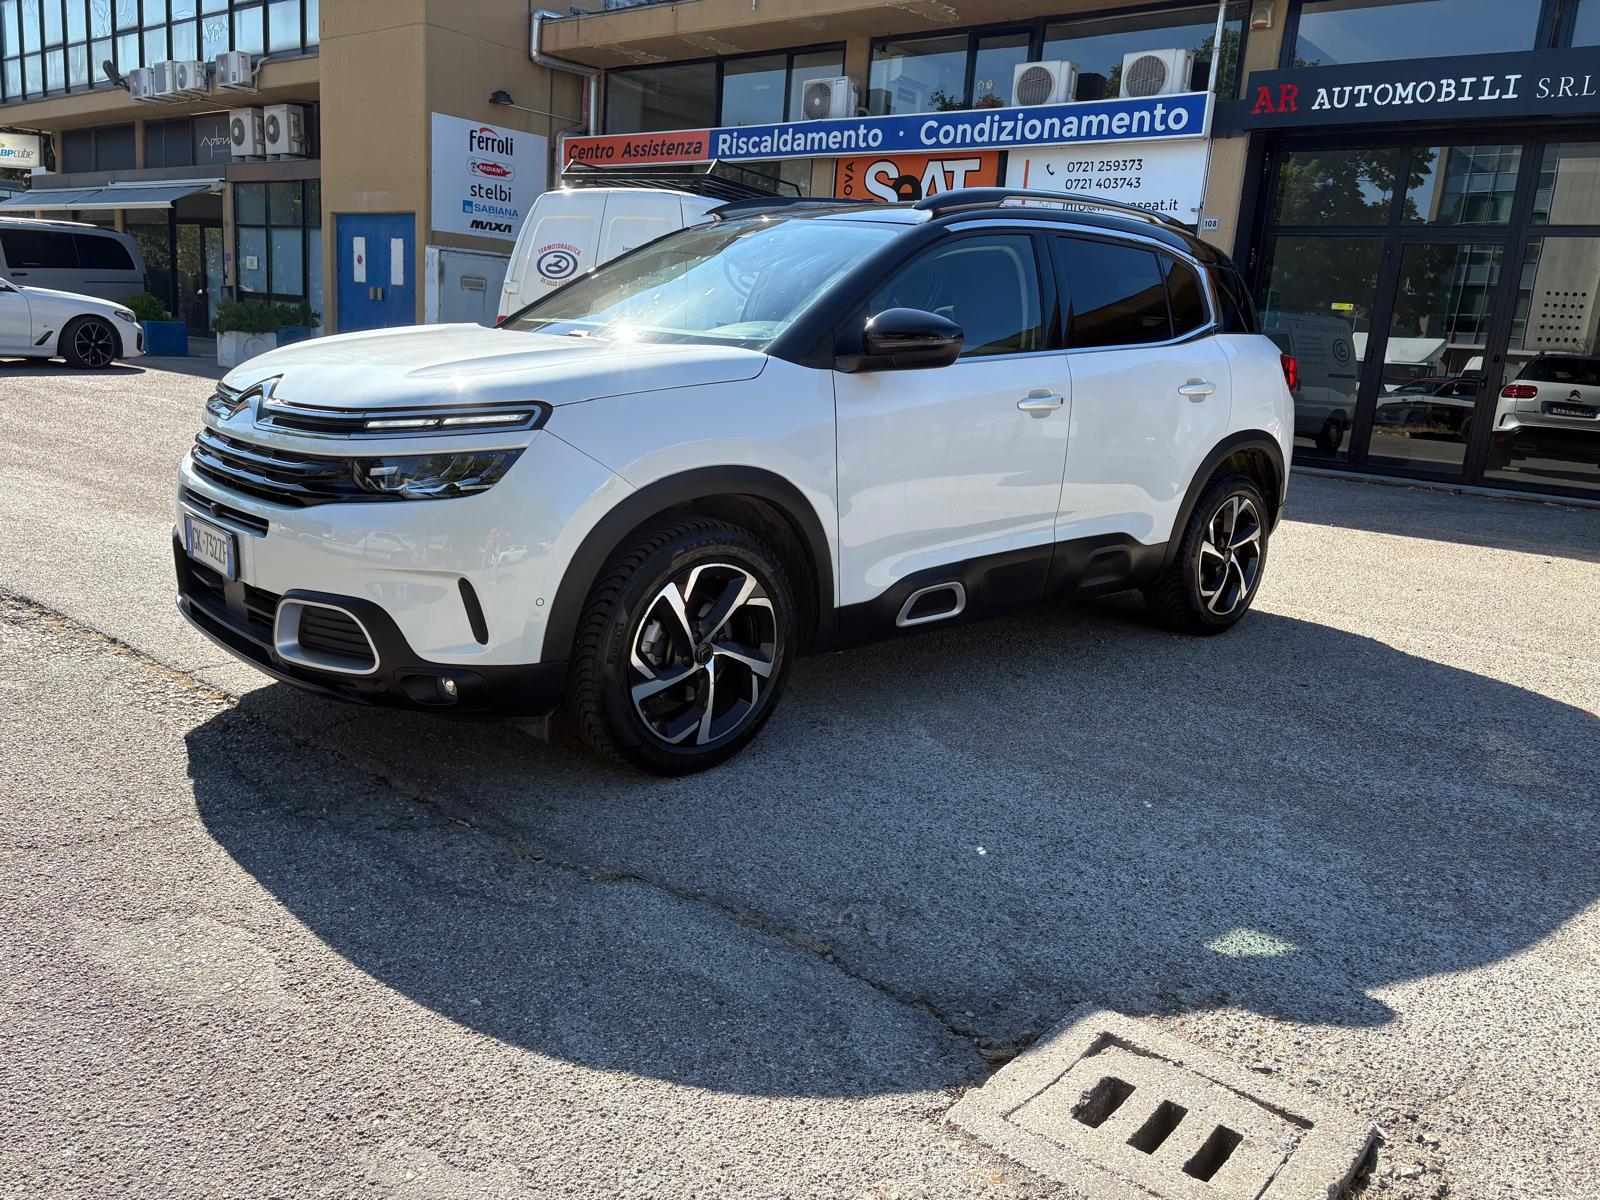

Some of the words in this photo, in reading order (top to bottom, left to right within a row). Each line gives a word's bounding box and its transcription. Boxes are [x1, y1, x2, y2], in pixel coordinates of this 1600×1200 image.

[1250, 84, 1299, 114] AR
[1311, 74, 1522, 110] AUTOMOBILI
[568, 143, 615, 160] Centro
[621, 139, 703, 158] Assistenza
[717, 124, 883, 156] Riscaldamento
[919, 103, 1190, 146] Condizionamento
[469, 129, 514, 156] Ferroli
[1066, 161, 1095, 173] 0721
[1097, 158, 1143, 172] 259373
[843, 160, 856, 197] OVA
[1065, 178, 1093, 190] 0721
[1095, 177, 1142, 190] 403743
[470, 183, 512, 203] stelbi
[474, 203, 519, 217] SABIANA
[470, 219, 512, 233] MAXA
[1204, 219, 1217, 228] 108
[538, 243, 581, 257] TERMOIDRAULICA
